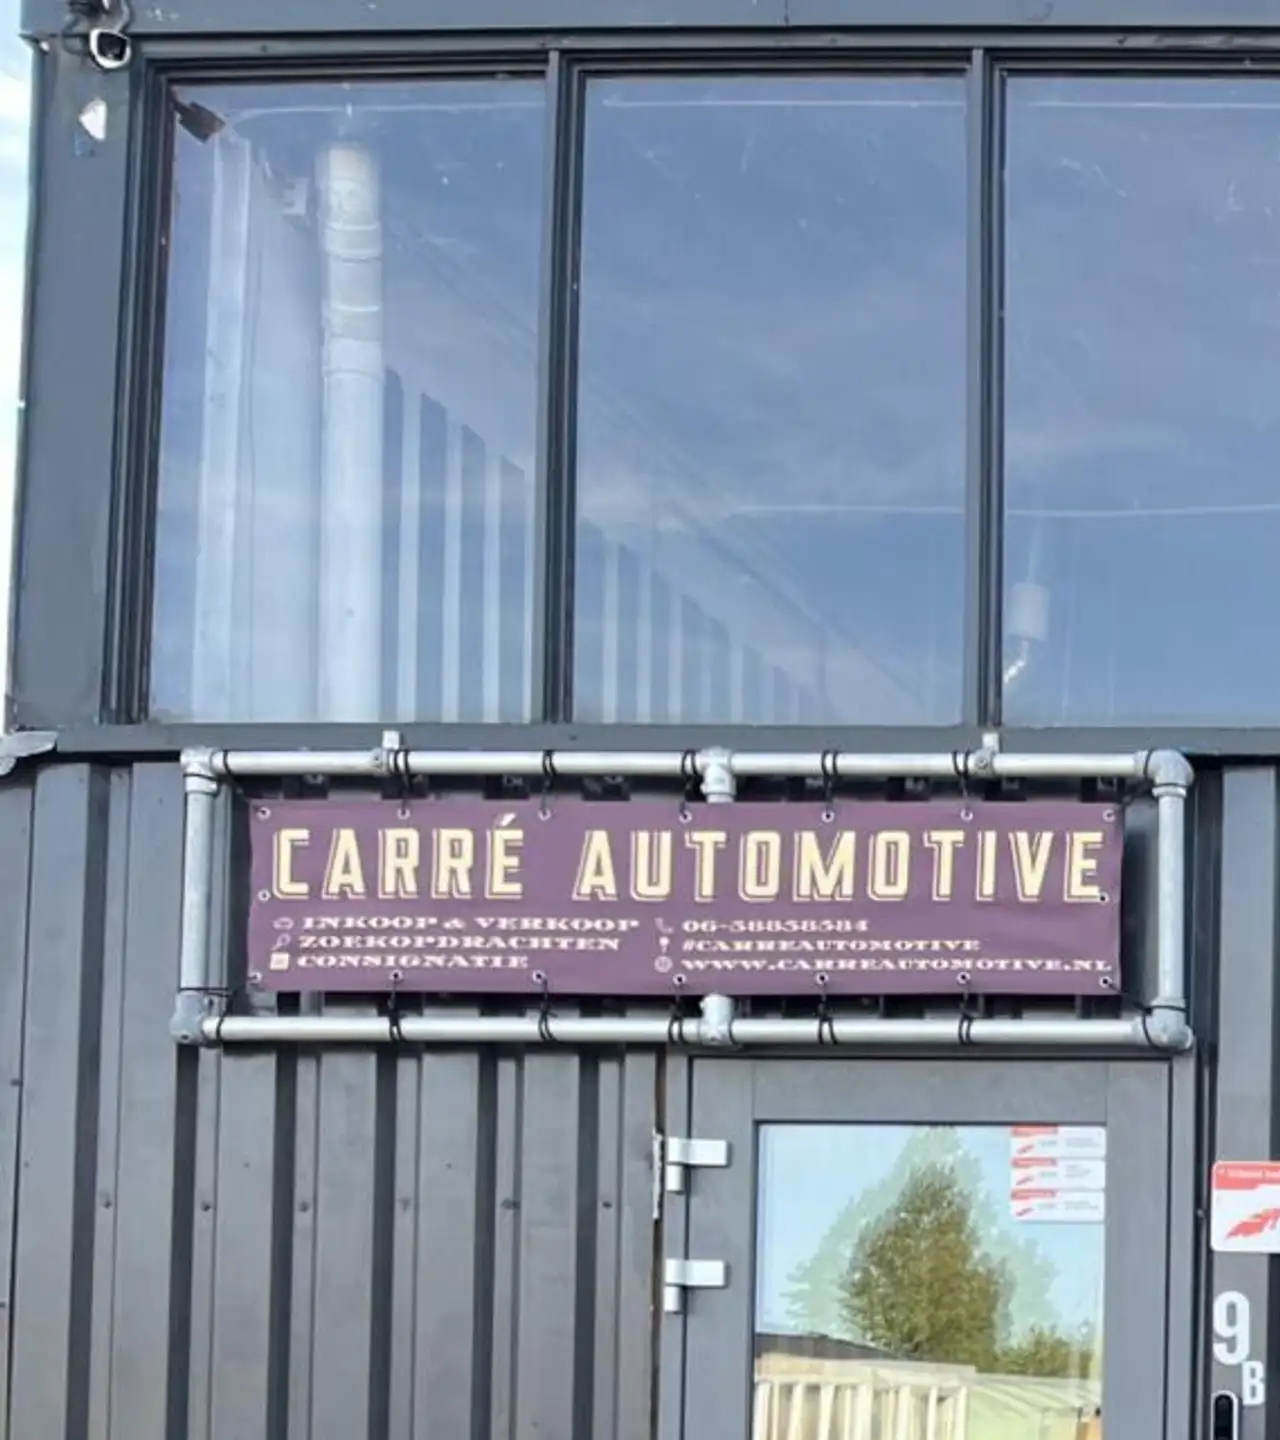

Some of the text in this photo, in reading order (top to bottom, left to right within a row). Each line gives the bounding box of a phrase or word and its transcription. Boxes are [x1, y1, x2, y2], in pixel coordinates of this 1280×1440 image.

[270, 813, 1106, 903] CARRÉ AUTOMOTIVE
[302, 915, 640, 933] INKOOP & VERKOOP
[298, 934, 621, 952] ZOEKOPDRACHTEN
[296, 954, 529, 969] CONSIGNATIE
[1213, 1290, 1250, 1366] 9
